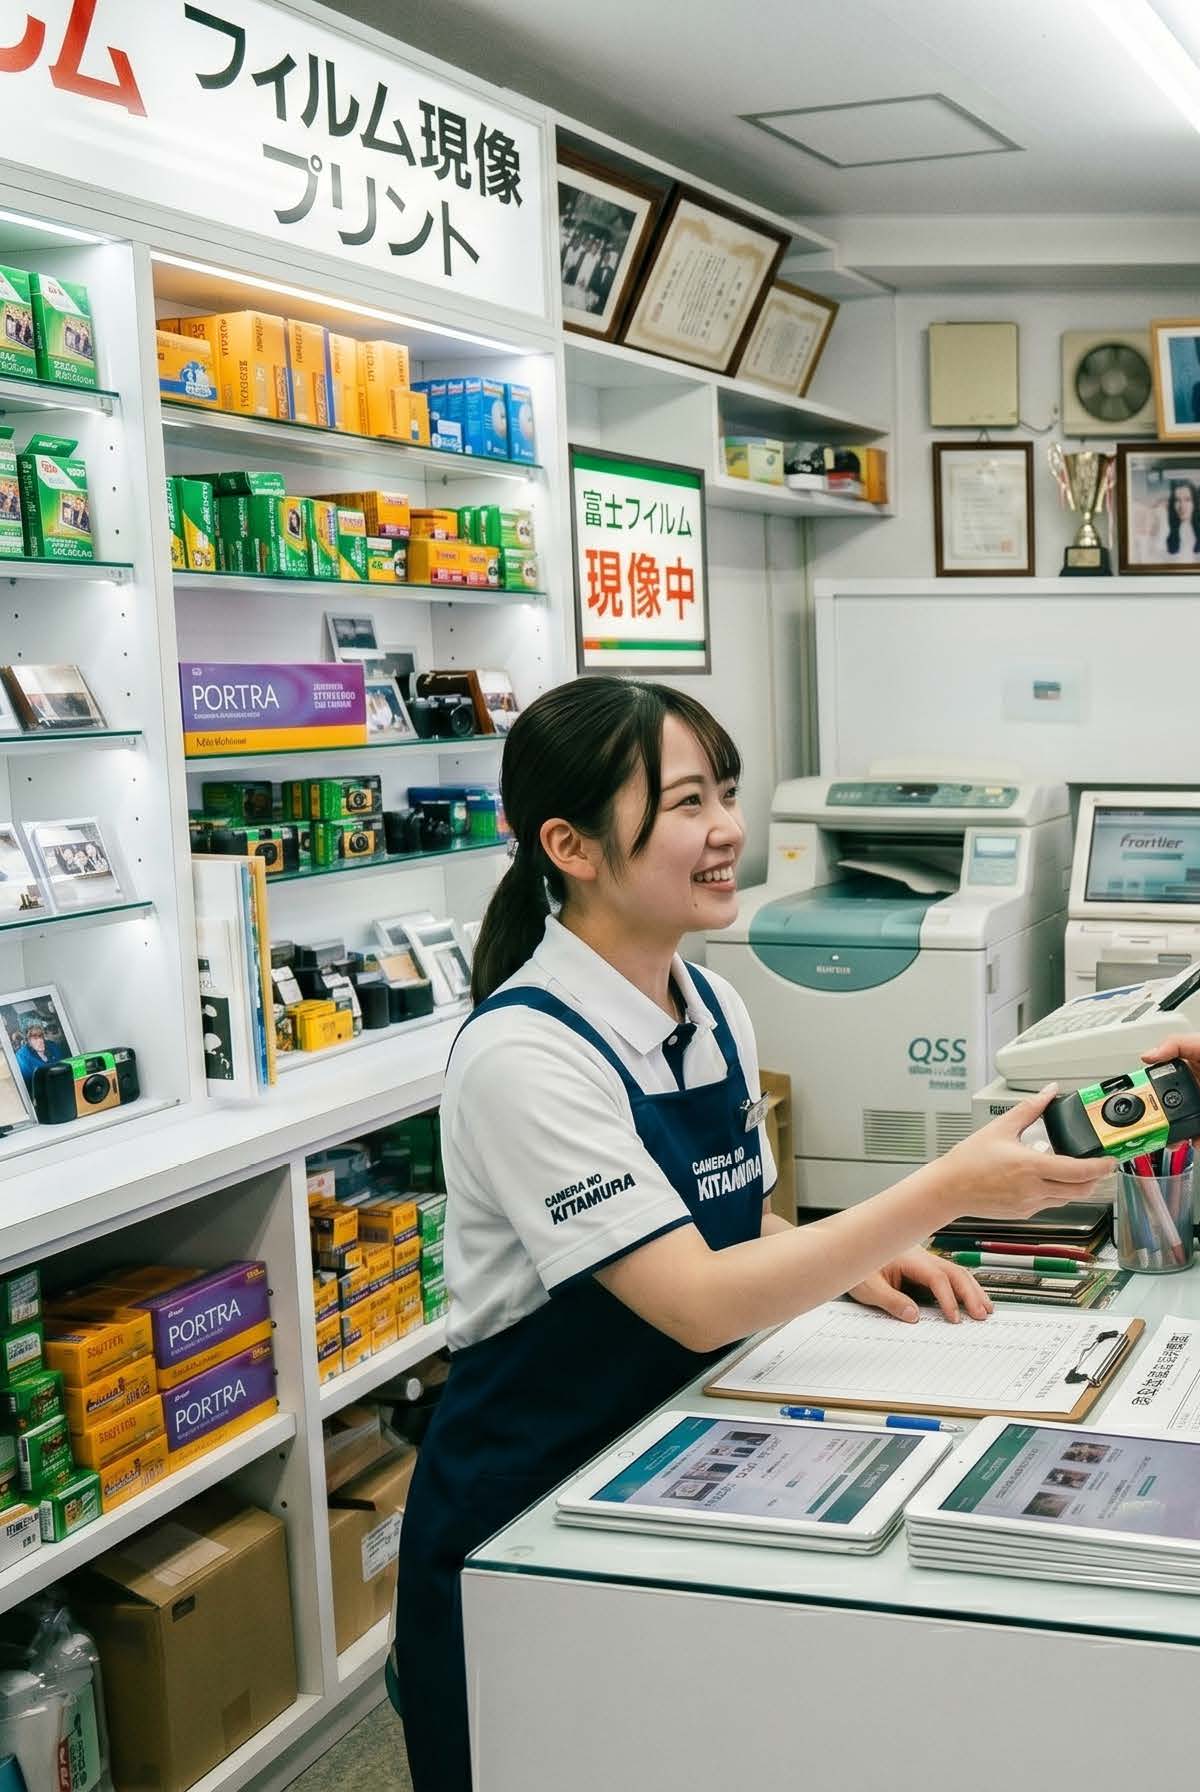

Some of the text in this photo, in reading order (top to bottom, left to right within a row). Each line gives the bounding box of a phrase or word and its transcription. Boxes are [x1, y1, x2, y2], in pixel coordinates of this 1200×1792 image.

[262, 143, 480, 277] プリント
[585, 549, 695, 621] 現像中
[192, 684, 280, 711] PORTRA
[908, 1038, 968, 1064] QSS
[550, 1172, 636, 1226] KITAMURA
[586, 1173, 602, 1188] NO
[168, 1299, 242, 1348] PORTRA
[175, 1379, 247, 1433] PORTRA
